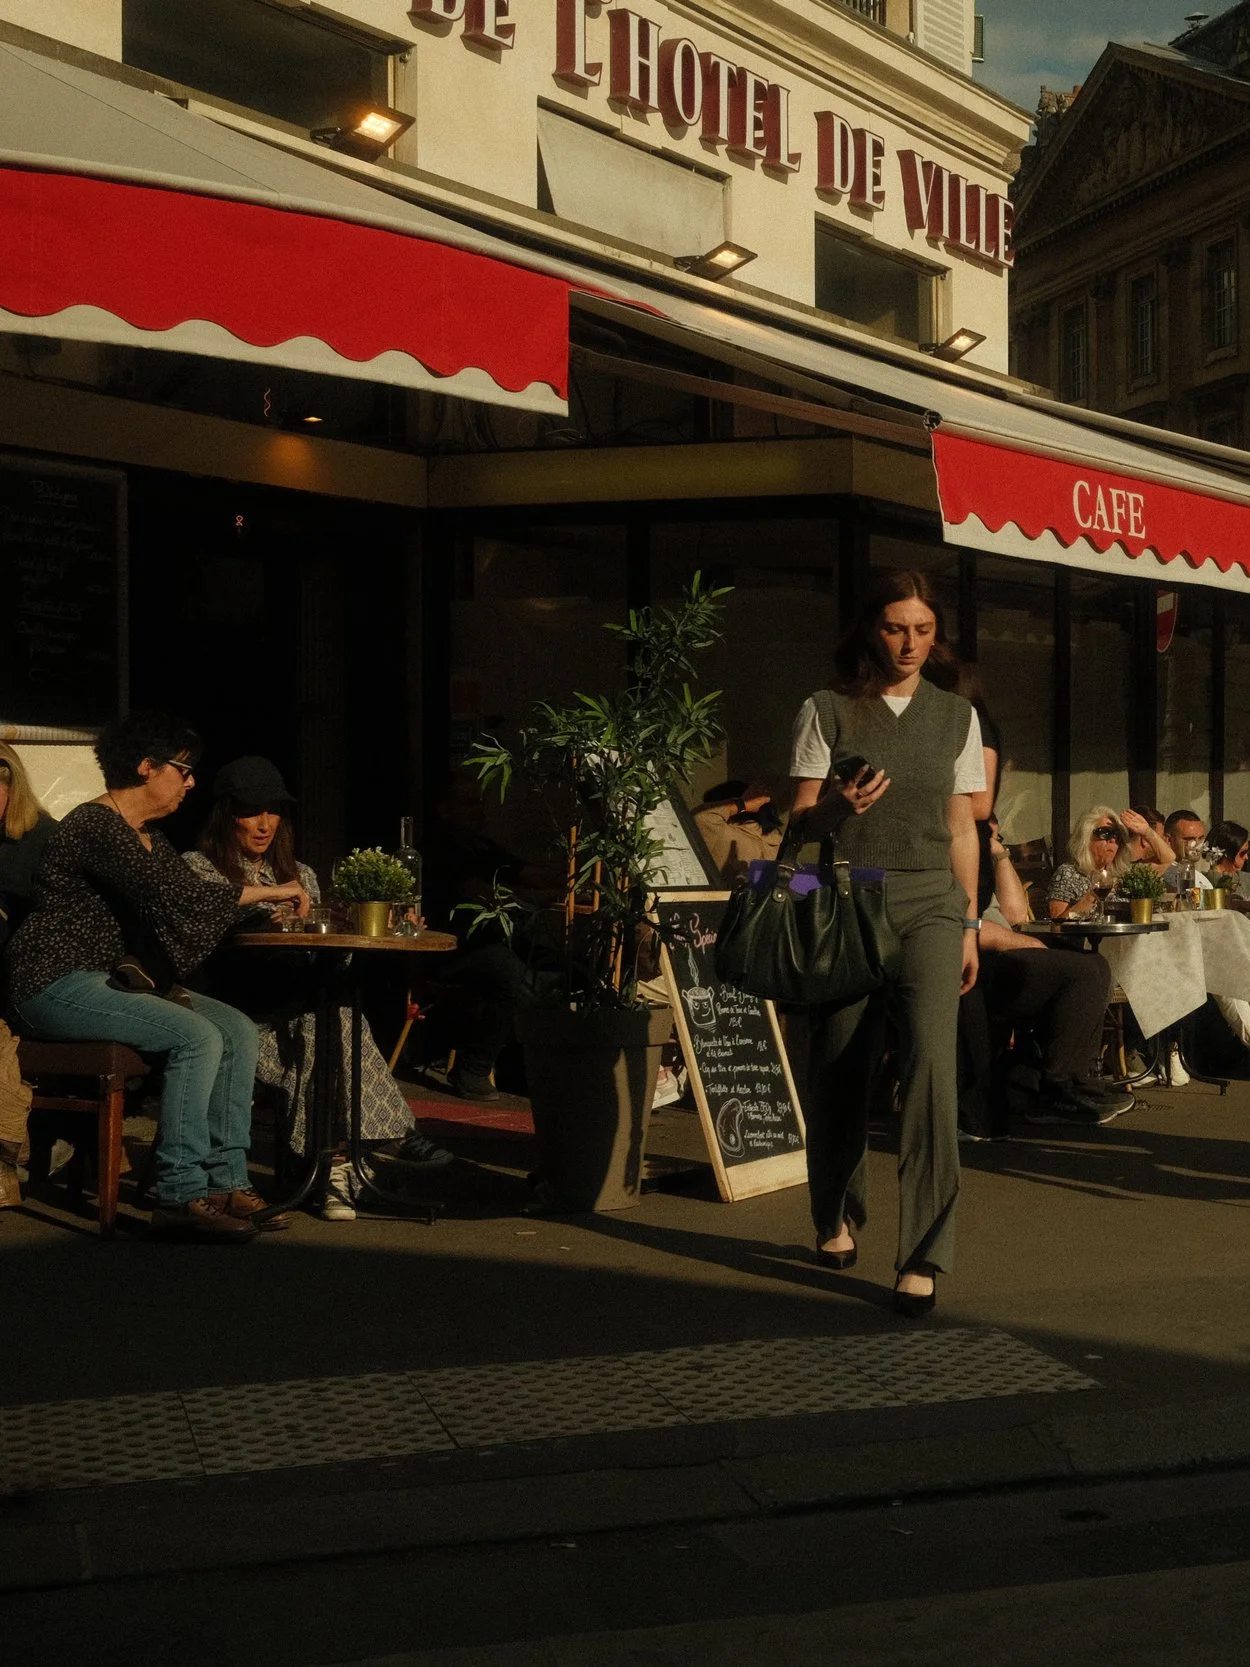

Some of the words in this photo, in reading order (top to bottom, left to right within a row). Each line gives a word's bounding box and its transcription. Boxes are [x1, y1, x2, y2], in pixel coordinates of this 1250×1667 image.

[814, 111, 885, 211] DE
[896, 149, 1015, 268] VILLE
[1073, 479, 1147, 539] CAFE
